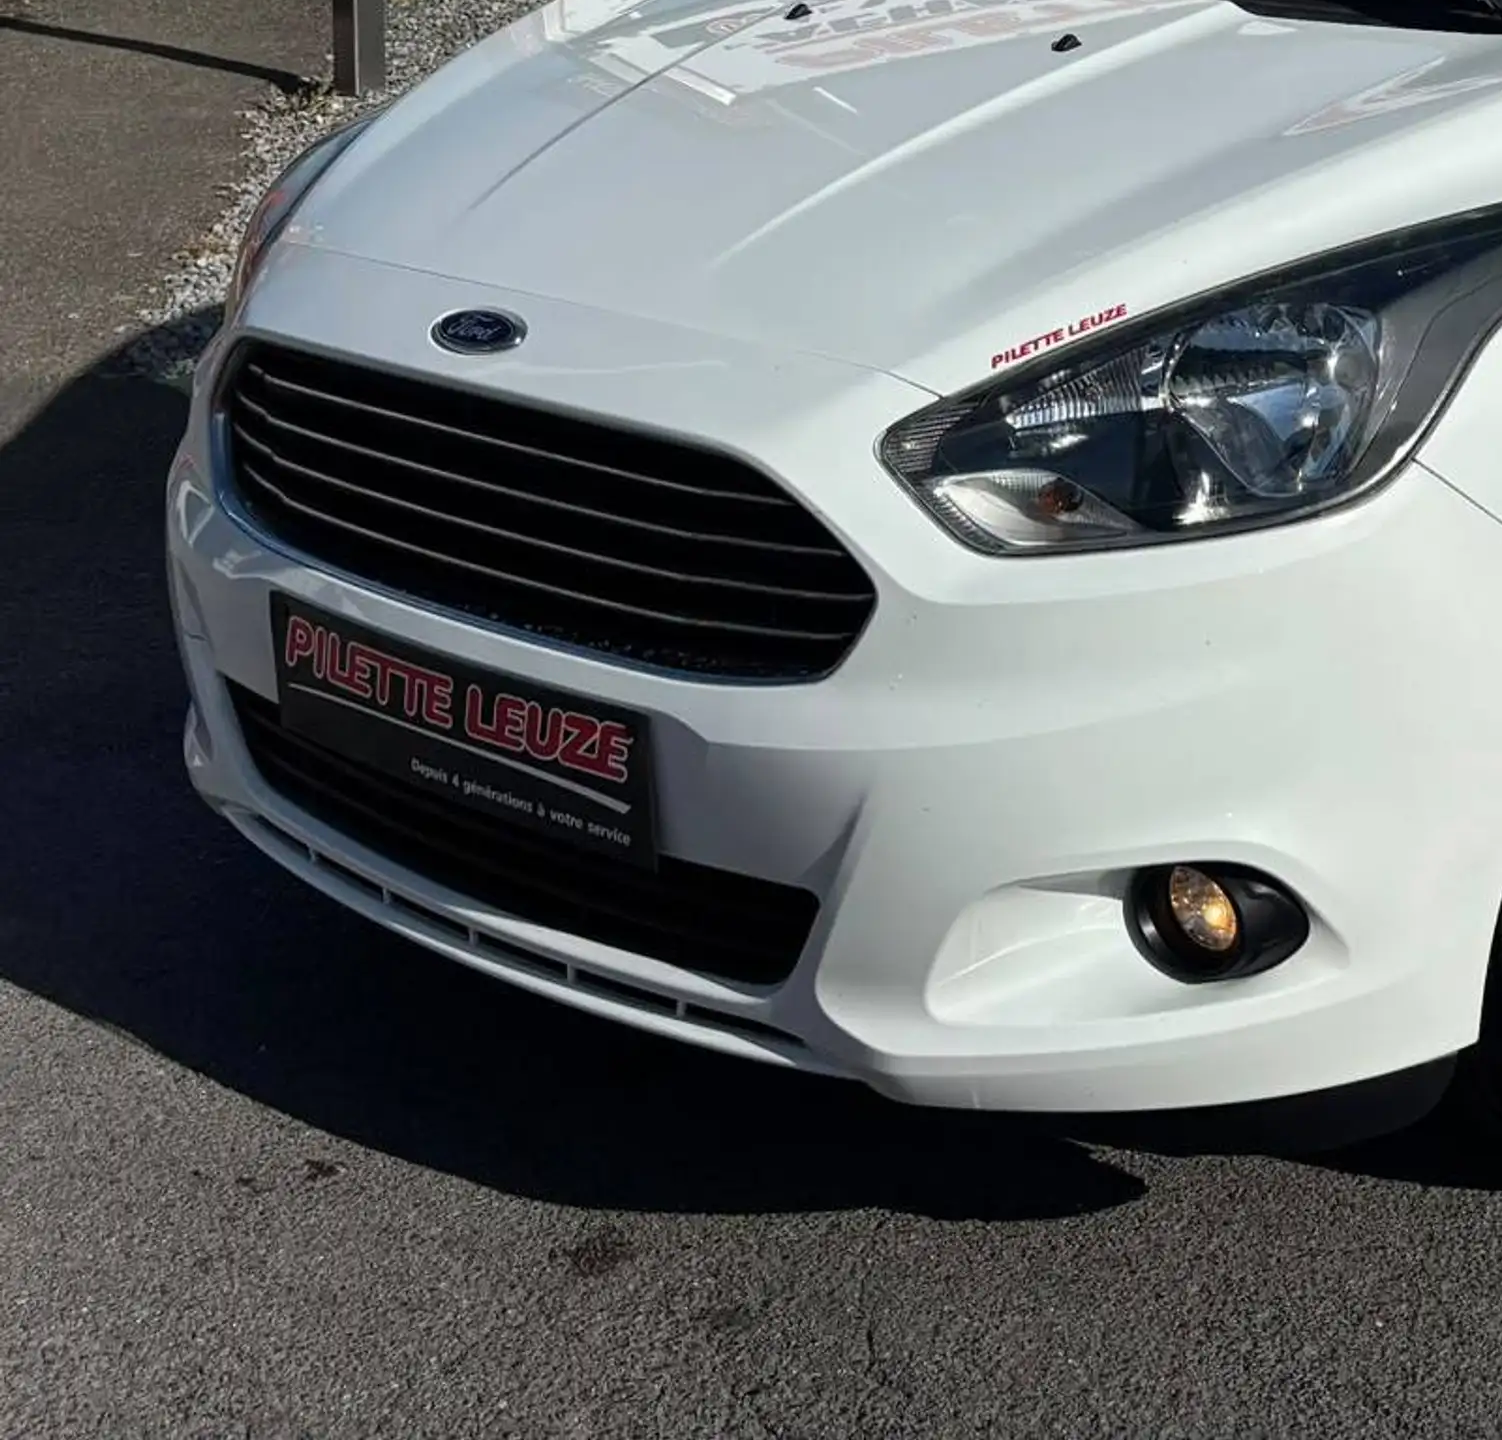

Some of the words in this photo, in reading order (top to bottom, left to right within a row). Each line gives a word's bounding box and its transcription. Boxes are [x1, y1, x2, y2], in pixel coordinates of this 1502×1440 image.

[991, 328, 1065, 369] PILETTE
[1068, 303, 1128, 336] LEUZE
[286, 616, 453, 729] PILETTE
[465, 684, 634, 783] LEUZE
[411, 757, 448, 784] Depuis
[452, 773, 460, 787] 4
[463, 779, 533, 813] générations
[550, 809, 583, 830] votre
[587, 821, 631, 847] service
